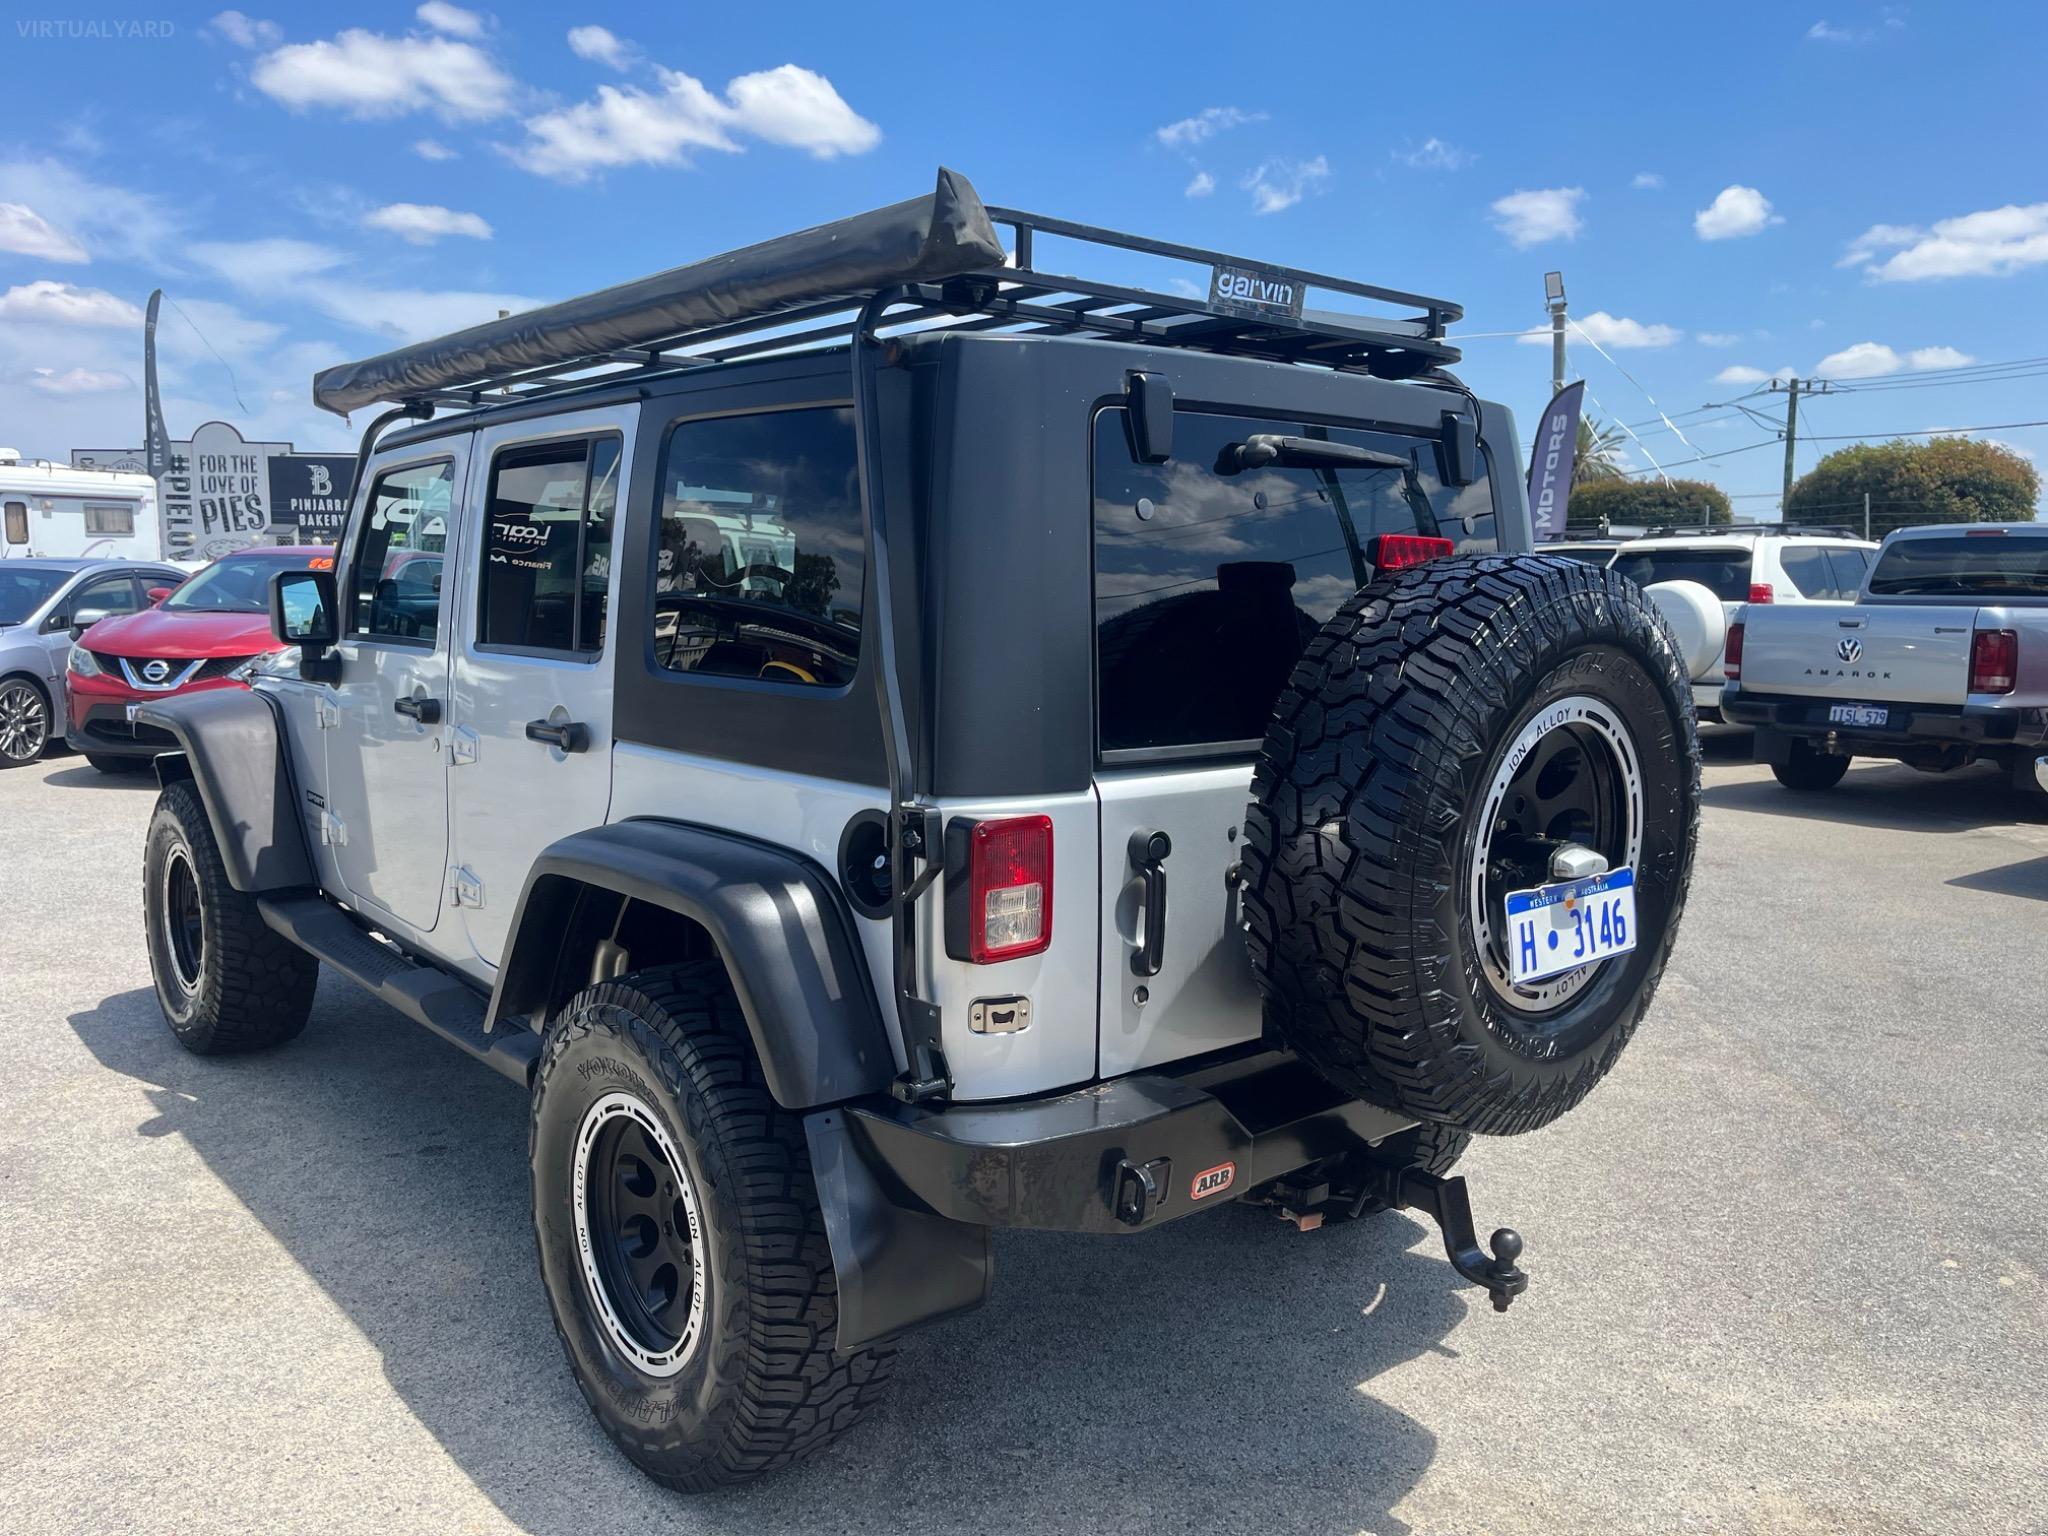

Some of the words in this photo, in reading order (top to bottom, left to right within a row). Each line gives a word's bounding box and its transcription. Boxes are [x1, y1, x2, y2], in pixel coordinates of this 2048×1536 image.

[1217, 273, 1293, 305] garvin
[200, 455, 227, 473] FOR
[230, 455, 258, 473] THE
[1535, 414, 1567, 528] MOTORS
[201, 475, 235, 494] LOVE
[241, 476, 258, 494] OF
[200, 494, 265, 534] PIES
[299, 514, 345, 527] BAKERY
[1804, 668, 1891, 679] AMAROK
[1508, 744, 1527, 772] ION
[1536, 707, 1571, 739] ALLOY
[1555, 965, 1587, 997] ALLOY
[1197, 1168, 1230, 1193] ARB
[579, 1227, 589, 1253] ION
[688, 1211, 698, 1239] ION
[693, 1259, 702, 1314] ALLOY
